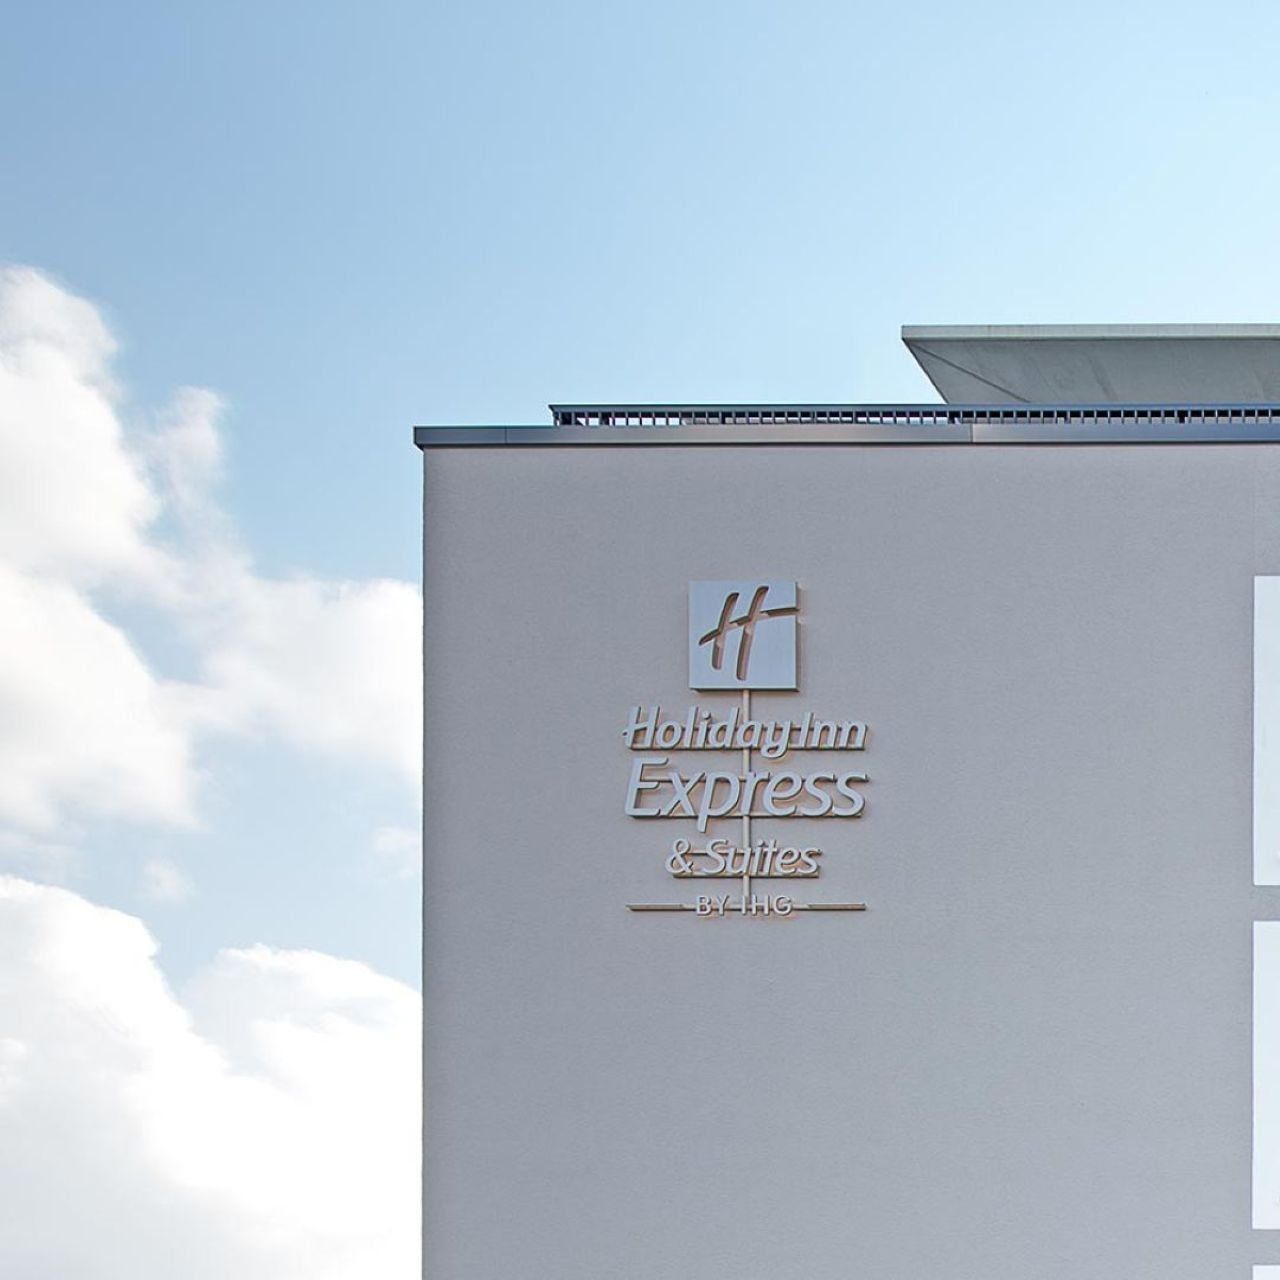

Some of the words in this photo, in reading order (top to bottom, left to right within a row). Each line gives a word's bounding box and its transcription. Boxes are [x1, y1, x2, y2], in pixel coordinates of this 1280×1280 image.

[621, 705, 792, 759] Holiday
[800, 711, 869, 751] Inn
[624, 756, 870, 833] Express
[665, 838, 694, 875] &
[701, 838, 823, 876] Suites
[696, 895, 730, 916] BY
[741, 895, 793, 916] IHG
